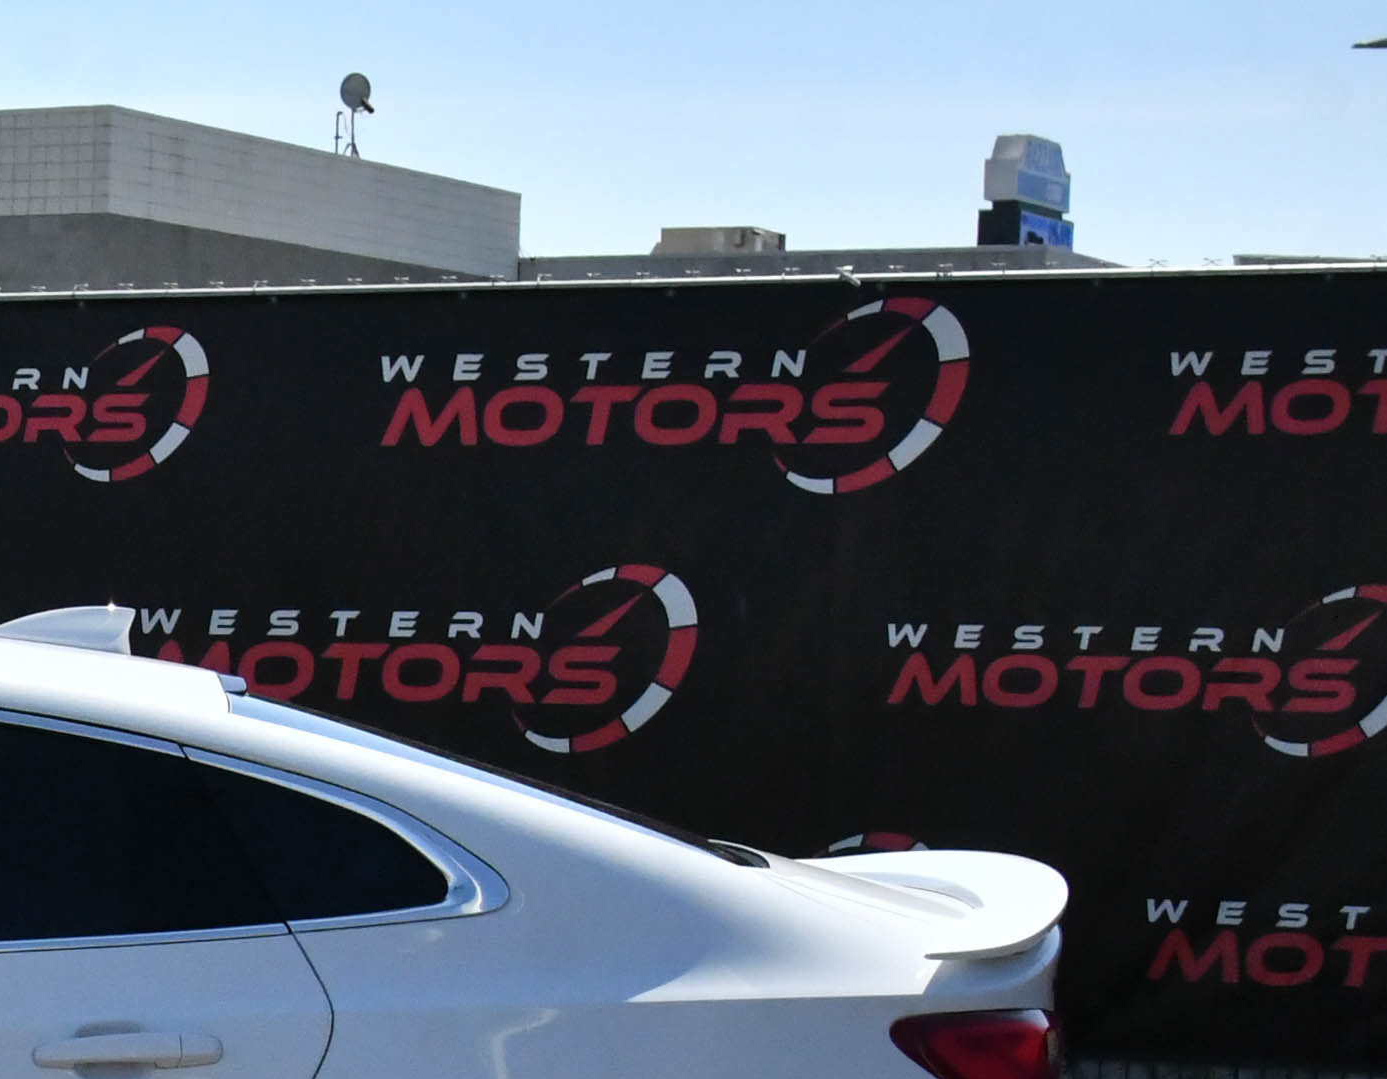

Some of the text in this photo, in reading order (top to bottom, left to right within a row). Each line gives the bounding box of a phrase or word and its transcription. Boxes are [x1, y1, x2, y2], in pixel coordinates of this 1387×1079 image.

[381, 350, 806, 382] WESTERN
[382, 382, 888, 446] MOTORS
[141, 608, 543, 639] WESTERN
[888, 624, 1284, 652] WESTERN
[890, 648, 1358, 712] MOTORS
